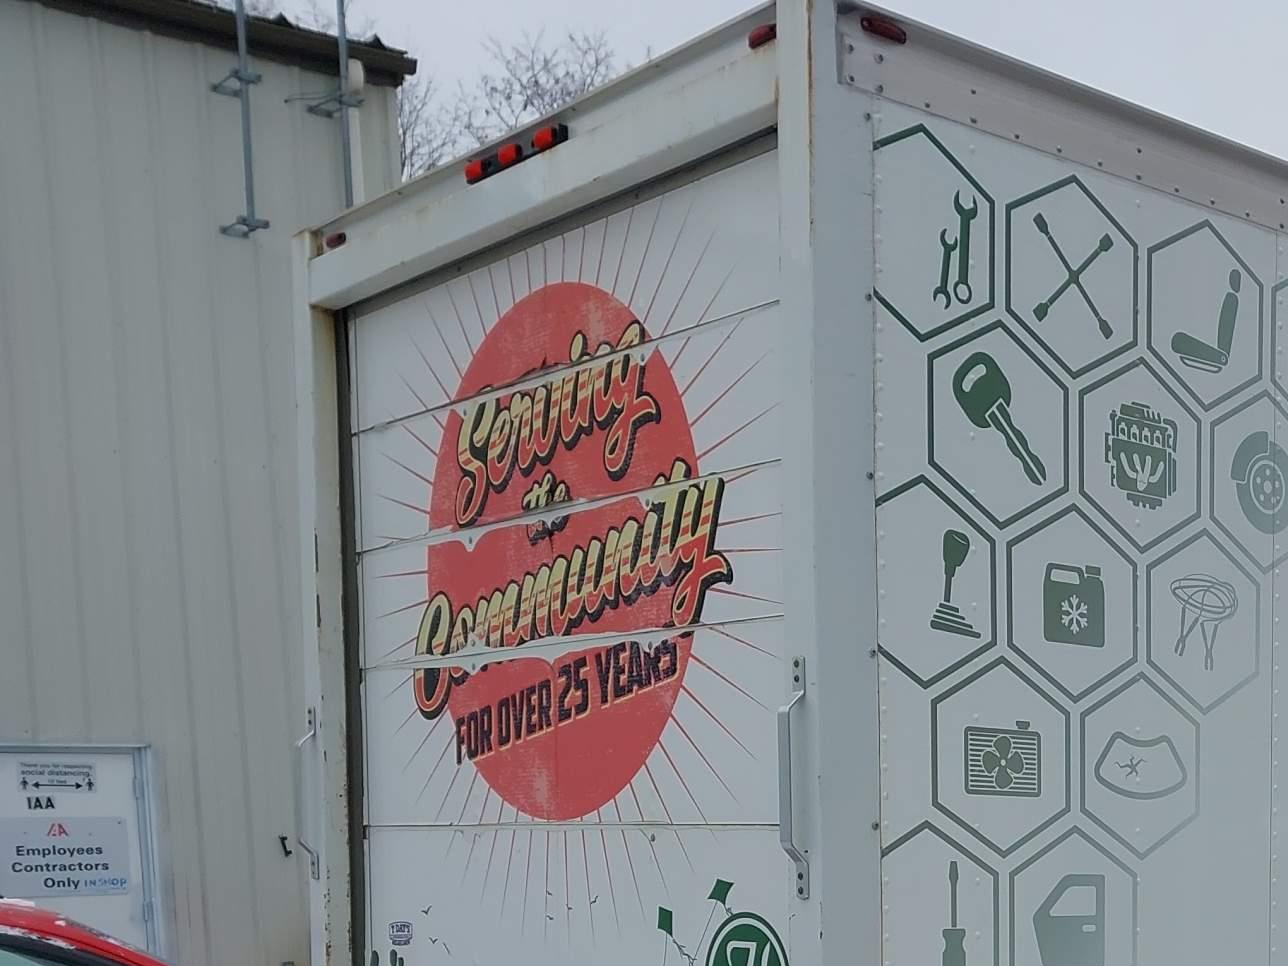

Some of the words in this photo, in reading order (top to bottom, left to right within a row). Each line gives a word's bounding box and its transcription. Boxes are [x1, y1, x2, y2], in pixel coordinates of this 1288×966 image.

[455, 319, 661, 528] Serving
[521, 469, 575, 545] the
[413, 455, 734, 720] Community
[455, 704, 494, 766] FOR
[498, 674, 555, 746] OVER
[557, 653, 591, 726] 25
[594, 636, 680, 707] YEARS
[26, 796, 56, 810] IAA
[11, 861, 110, 873] Contractors
[15, 844, 104, 858] Employees
[43, 876, 80, 890] Only
